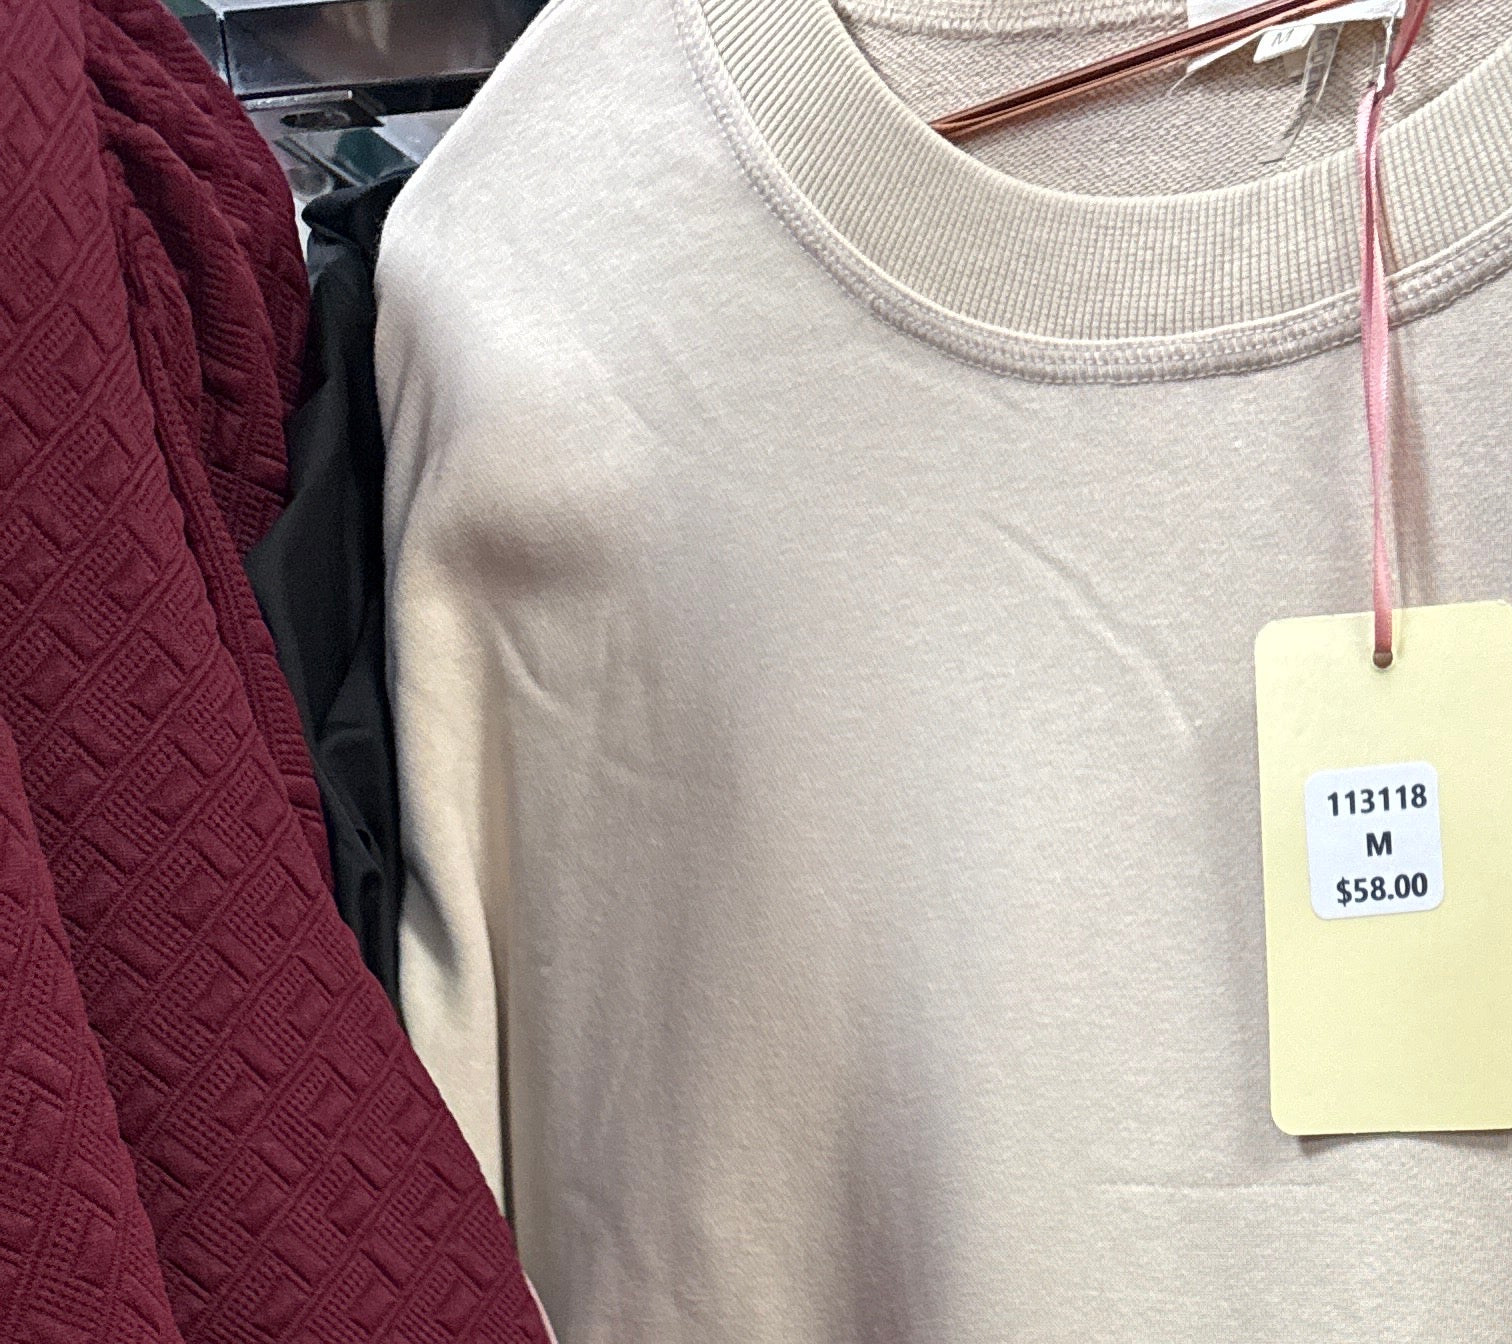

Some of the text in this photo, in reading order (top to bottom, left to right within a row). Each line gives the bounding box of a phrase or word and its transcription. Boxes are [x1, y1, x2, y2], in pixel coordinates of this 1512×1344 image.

[1271, 27, 1294, 47] M
[1327, 783, 1427, 817] 113118
[1366, 831, 1393, 857] M
[1336, 872, 1428, 907] $58.00
